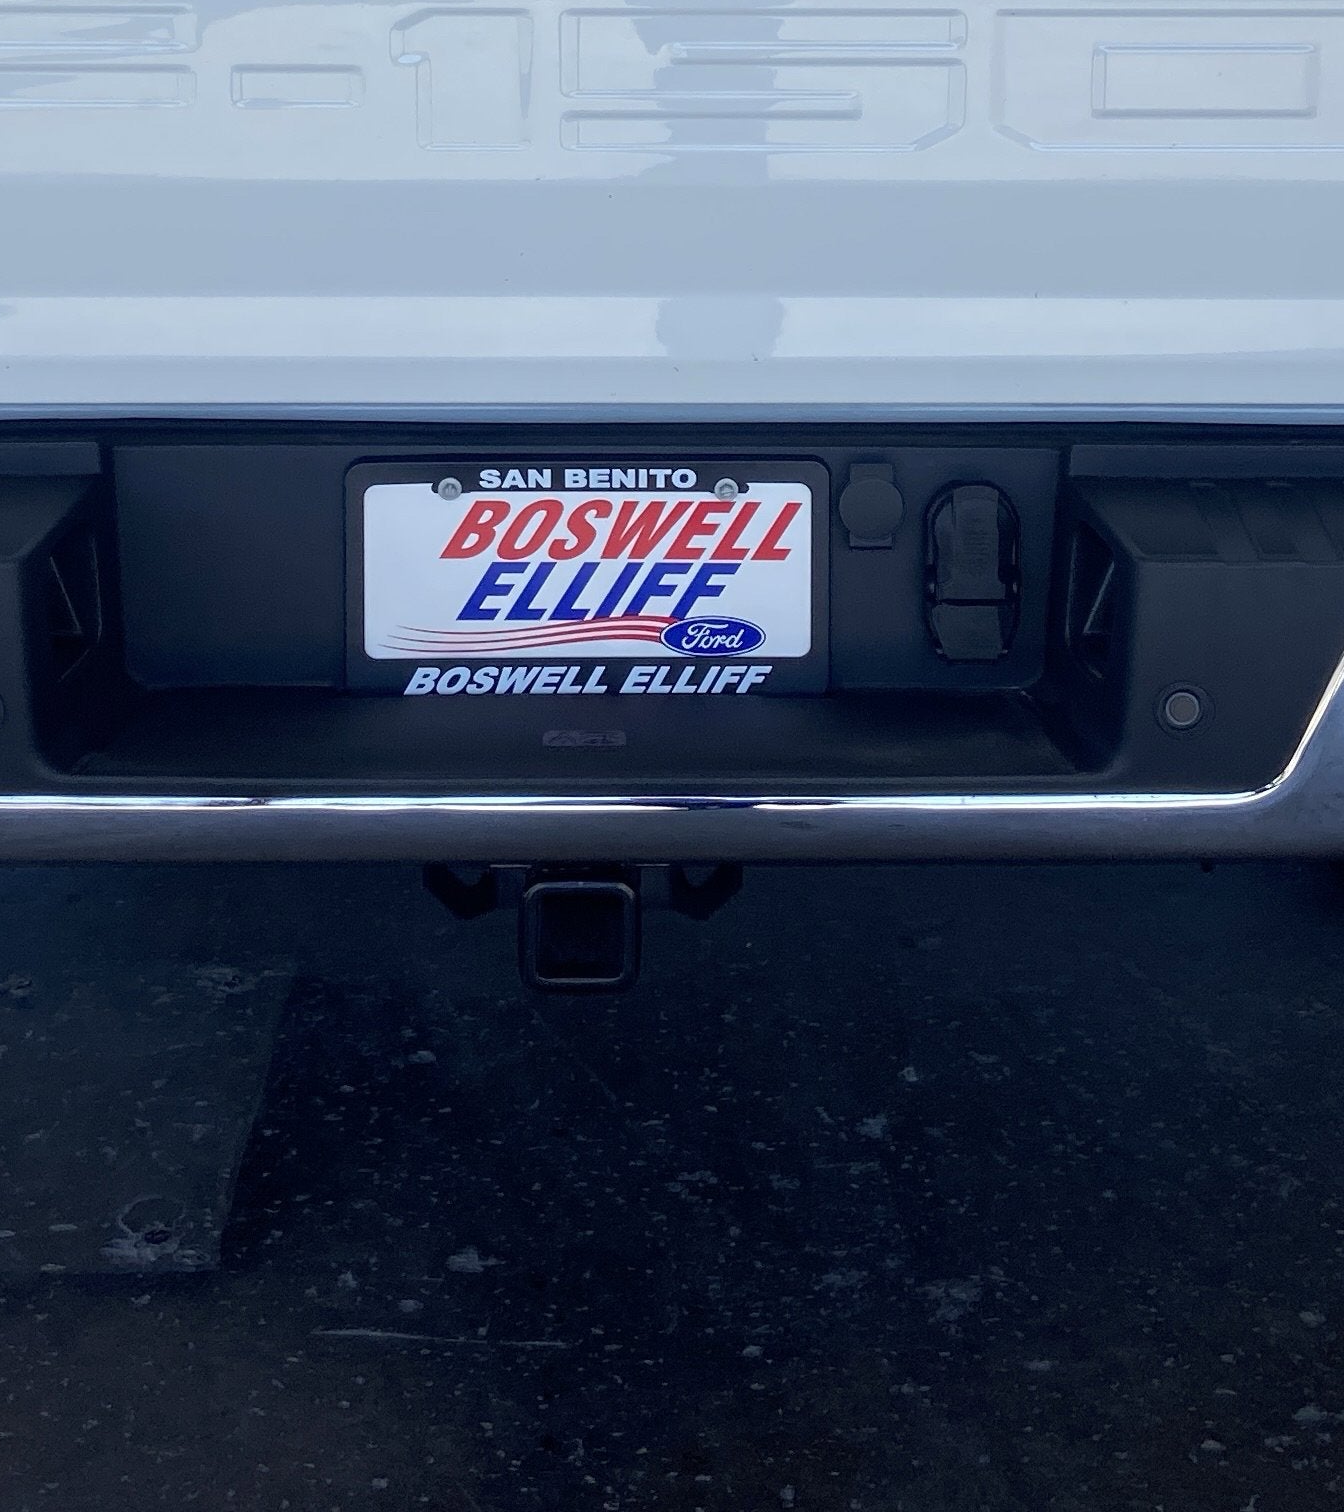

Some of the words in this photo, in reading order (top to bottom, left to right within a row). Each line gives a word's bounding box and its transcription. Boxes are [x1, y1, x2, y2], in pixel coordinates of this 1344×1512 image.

[478, 468, 553, 489] SAN
[563, 468, 697, 489] BENITO
[440, 498, 803, 561] BOSWELL
[456, 561, 743, 621] ELLIFF
[681, 623, 744, 650] Ford
[403, 665, 609, 696] BOSWELL
[618, 665, 774, 696] ELLIFF
